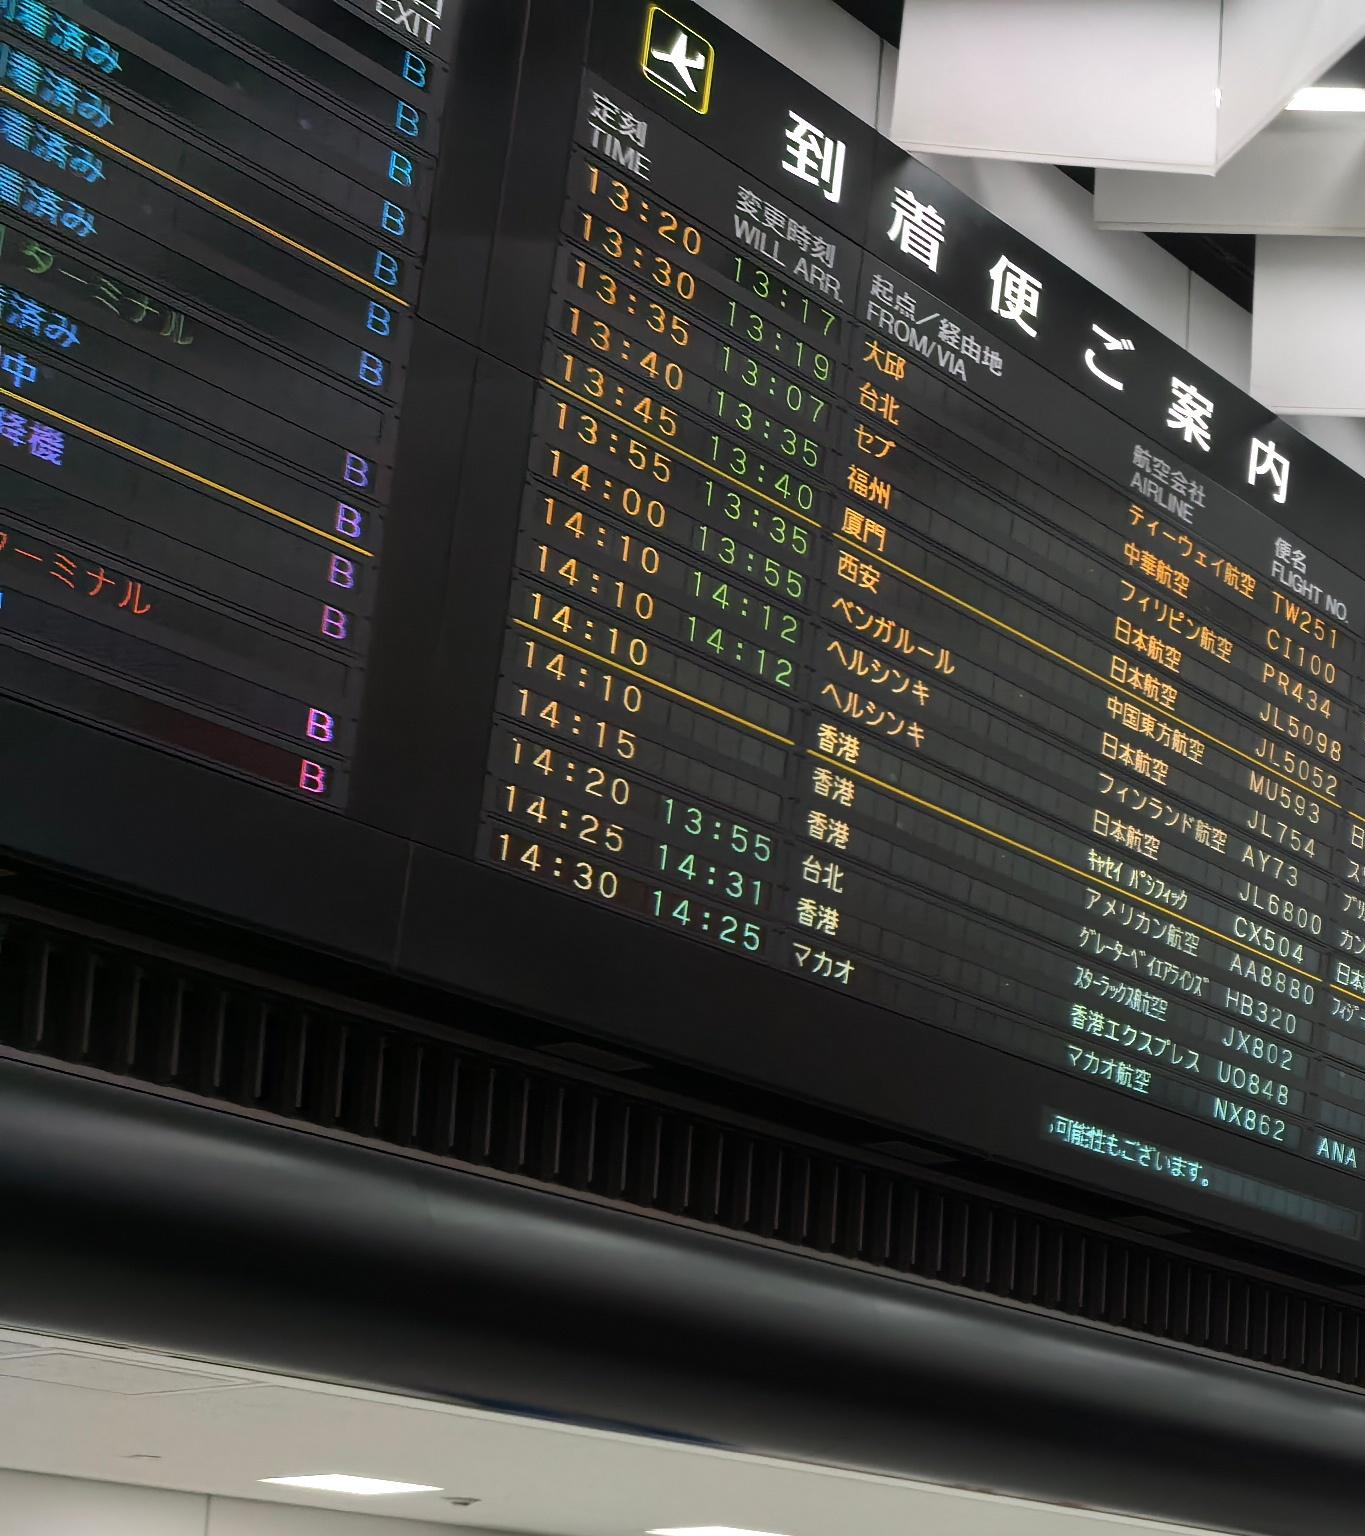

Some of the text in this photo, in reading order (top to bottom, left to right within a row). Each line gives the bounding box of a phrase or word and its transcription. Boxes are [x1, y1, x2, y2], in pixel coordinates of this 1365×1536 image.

[376, 0, 443, 45] EXIT
[402, 51, 427, 89] B
[396, 100, 420, 138] B
[588, 122, 652, 182] TIME
[589, 90, 649, 149] 定刻
[381, 200, 406, 237] B
[733, 214, 787, 267] WILL
[737, 184, 837, 270] 変更時刻
[781, 108, 1290, 505] 到着便ご案内
[866, 302, 969, 382] FROM/VIA
[581, 213, 696, 301] 13:30
[727, 301, 831, 382] 13:19
[858, 382, 900, 427] 台北
[1266, 628, 1338, 685] CI100
[587, 163, 702, 255] 13:20
[733, 257, 835, 337] 13:17
[1272, 590, 1339, 649] TW251
[344, 451, 369, 488] B
[574, 260, 690, 346] 13:35
[721, 347, 825, 424] 13:07
[1262, 665, 1332, 720] PR434
[1129, 471, 1194, 525] AIRLINE
[1131, 443, 1207, 509] 航空会社
[329, 554, 355, 589] B
[562, 354, 678, 437] 13:45
[709, 436, 813, 511] 13:40
[1255, 738, 1338, 797] JL5052
[568, 307, 1342, 763] 13:40 13:35 福州 JL5098
[1274, 536, 1307, 575] 便名
[556, 403, 1321, 825] 13:55 13:35 西安 MU593
[1271, 560, 1324, 609] FLIGHT
[543, 497, 1299, 887] 14:10 14:12 ヘルシンキ AY73
[548, 450, 667, 529] 14:00
[698, 526, 803, 597] 13:55
[1248, 810, 1316, 858] JL754
[305, 707, 335, 743] B
[537, 544, 1322, 935] 14:10 14:12 ヘルシンキ JL6800
[300, 759, 326, 794] B
[518, 688, 1297, 1035] 14:15 香港 HB320
[524, 640, 1314, 1003] 14:10 AA8880
[816, 723, 1304, 964] 香港 CX504
[504, 785, 1288, 1106] 14:25 14:31 香港 UO848
[512, 737, 1293, 1072] 14:20 13:55 台北 JX802
[498, 833, 619, 900] 14:30
[652, 889, 760, 951] 14:25
[791, 943, 856, 985] マカオ
[1212, 1097, 1285, 1142] NX862
[1317, 1137, 1357, 1169] ANA
